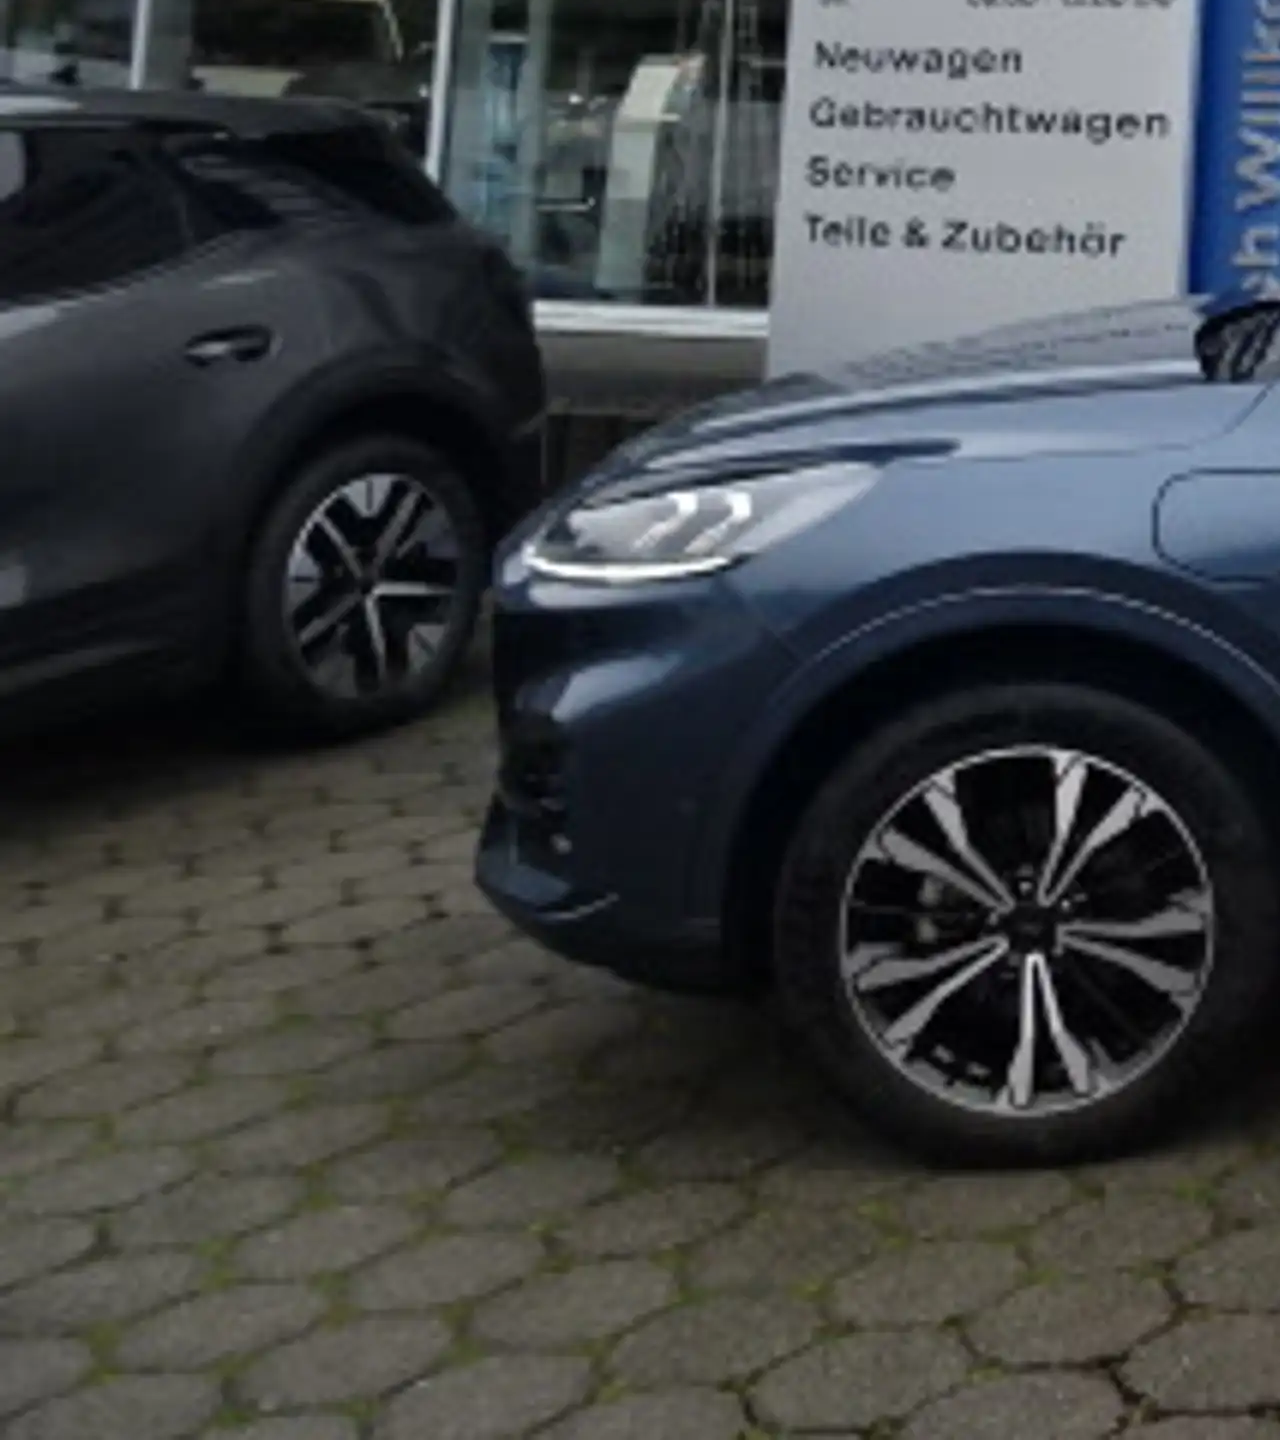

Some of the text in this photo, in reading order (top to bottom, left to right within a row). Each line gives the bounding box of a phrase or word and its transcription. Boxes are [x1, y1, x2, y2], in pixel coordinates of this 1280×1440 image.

[814, 40, 1023, 80] Neuwagen
[809, 96, 1171, 146] Gebrauchtwagen
[805, 155, 956, 192] Service
[805, 213, 1127, 258] Teile & Zubehör
